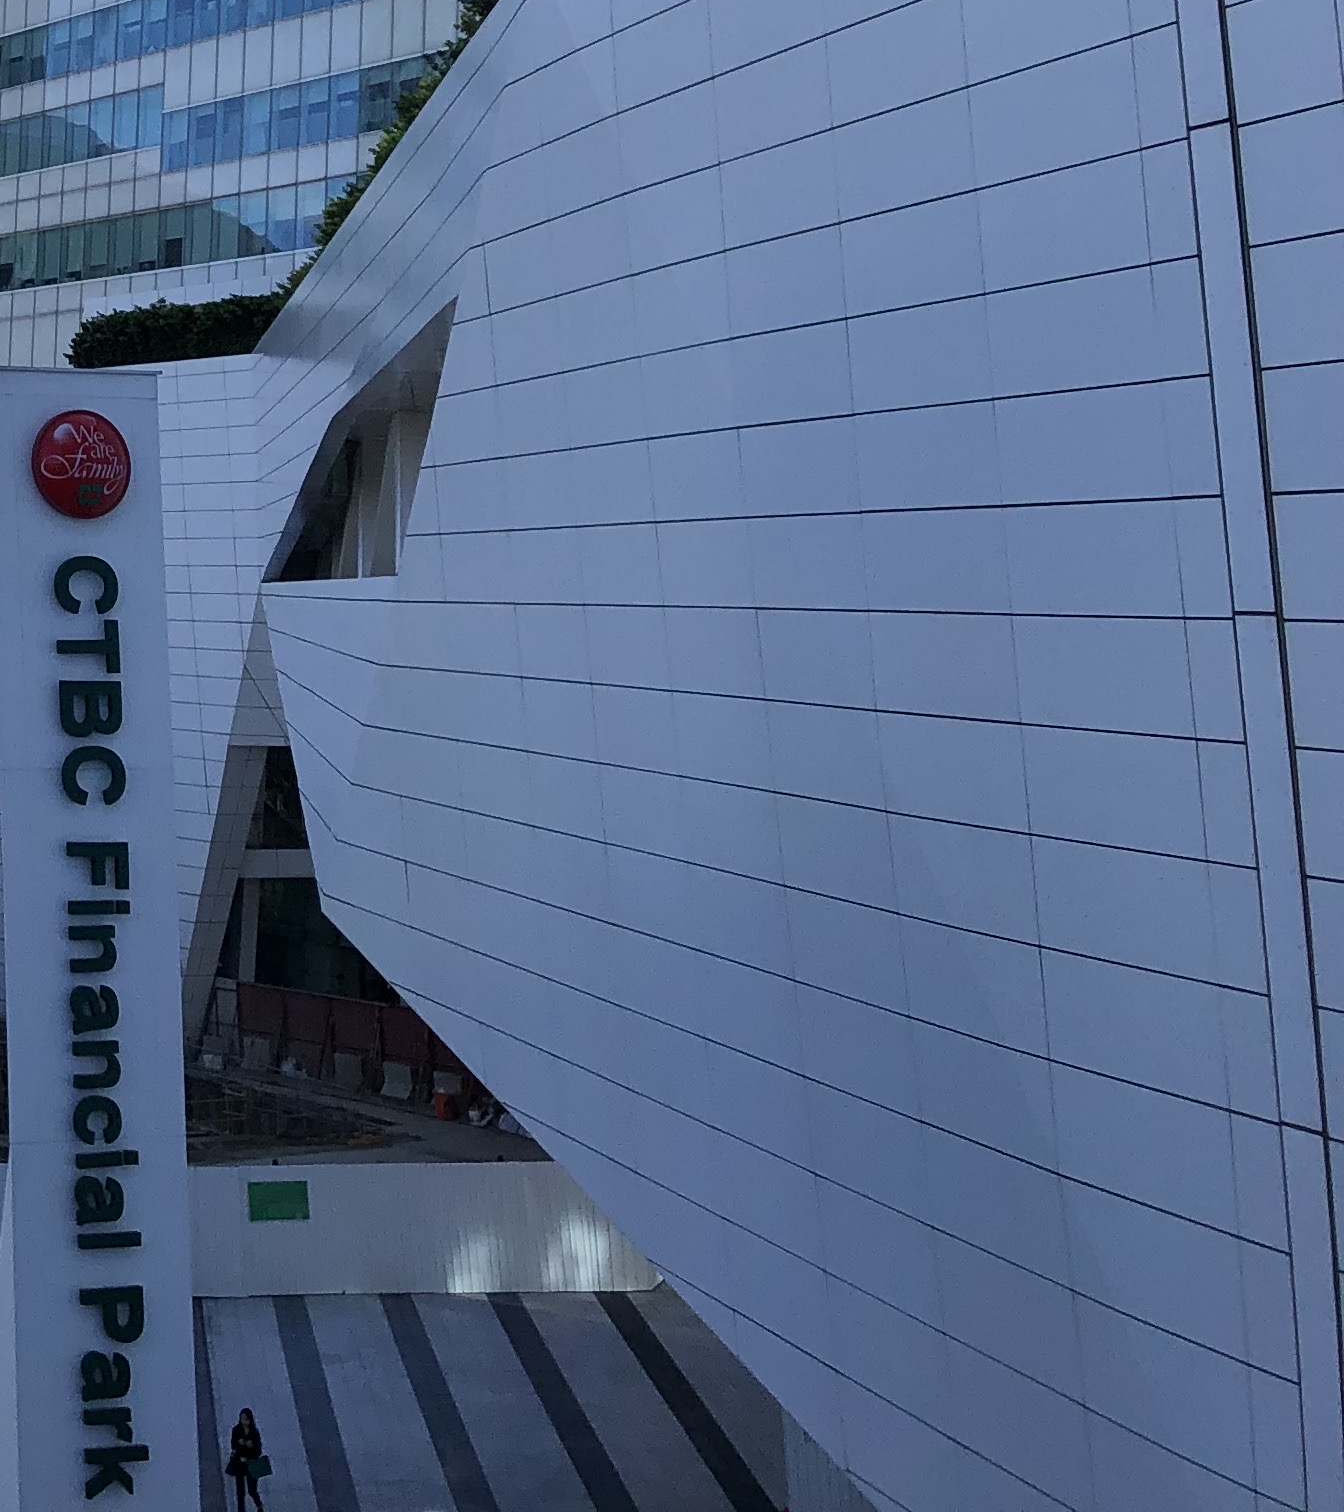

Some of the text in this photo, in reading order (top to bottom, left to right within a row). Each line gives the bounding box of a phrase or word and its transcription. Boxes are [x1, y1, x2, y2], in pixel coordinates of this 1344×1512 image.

[54, 422, 105, 444] We
[90, 442, 115, 460] are
[53, 555, 150, 1500] CTBC Financial Park
